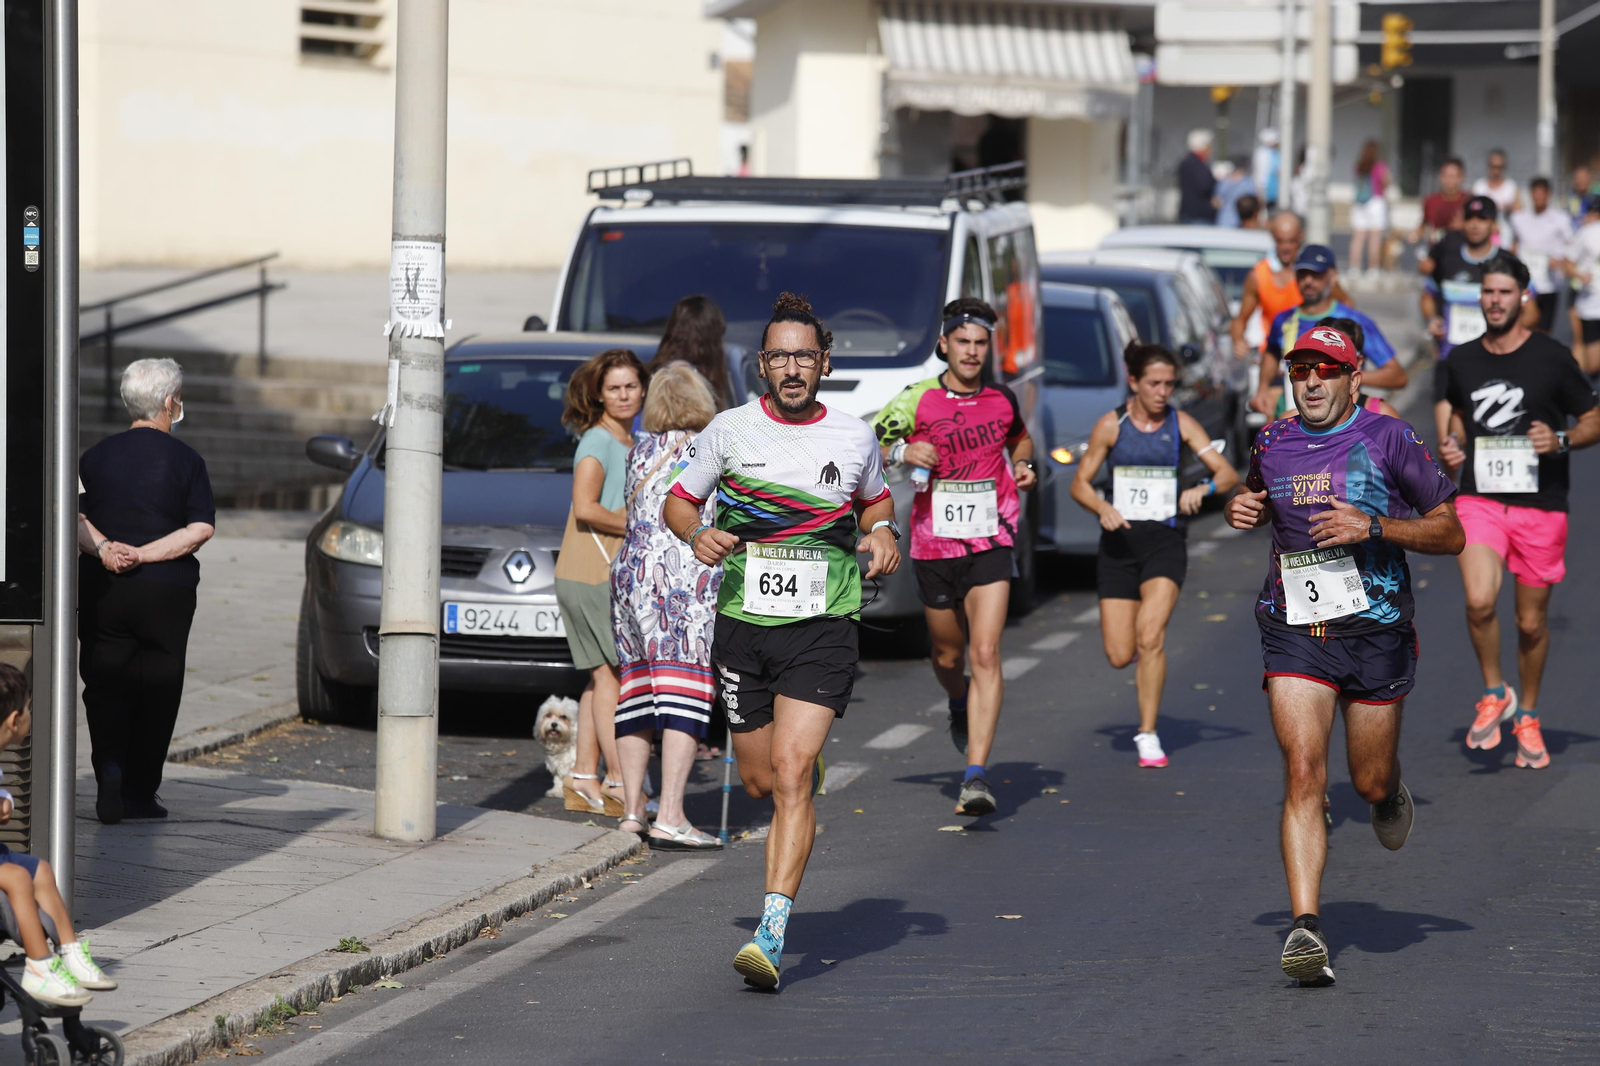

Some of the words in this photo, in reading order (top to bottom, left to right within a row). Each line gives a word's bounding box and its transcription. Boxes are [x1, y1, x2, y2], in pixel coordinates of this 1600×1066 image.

[1293, 473, 1331, 481] CONSIGUE
[1486, 460, 1513, 477] 191
[814, 484, 844, 492] FITNESS
[1293, 480, 1330, 492] VIVIR
[1129, 488, 1148, 505] 79
[945, 504, 976, 522] 617
[752, 547, 760, 556] 34
[762, 547, 787, 558] VUELTA
[789, 549, 795, 559] A
[796, 549, 822, 560] HUELVA
[1290, 554, 1311, 567] VUELTA
[1311, 554, 1317, 563] A
[1317, 547, 1346, 561] HUELVA
[759, 572, 798, 597] 634
[1305, 580, 1320, 602] 3
[464, 608, 519, 630] 9244
